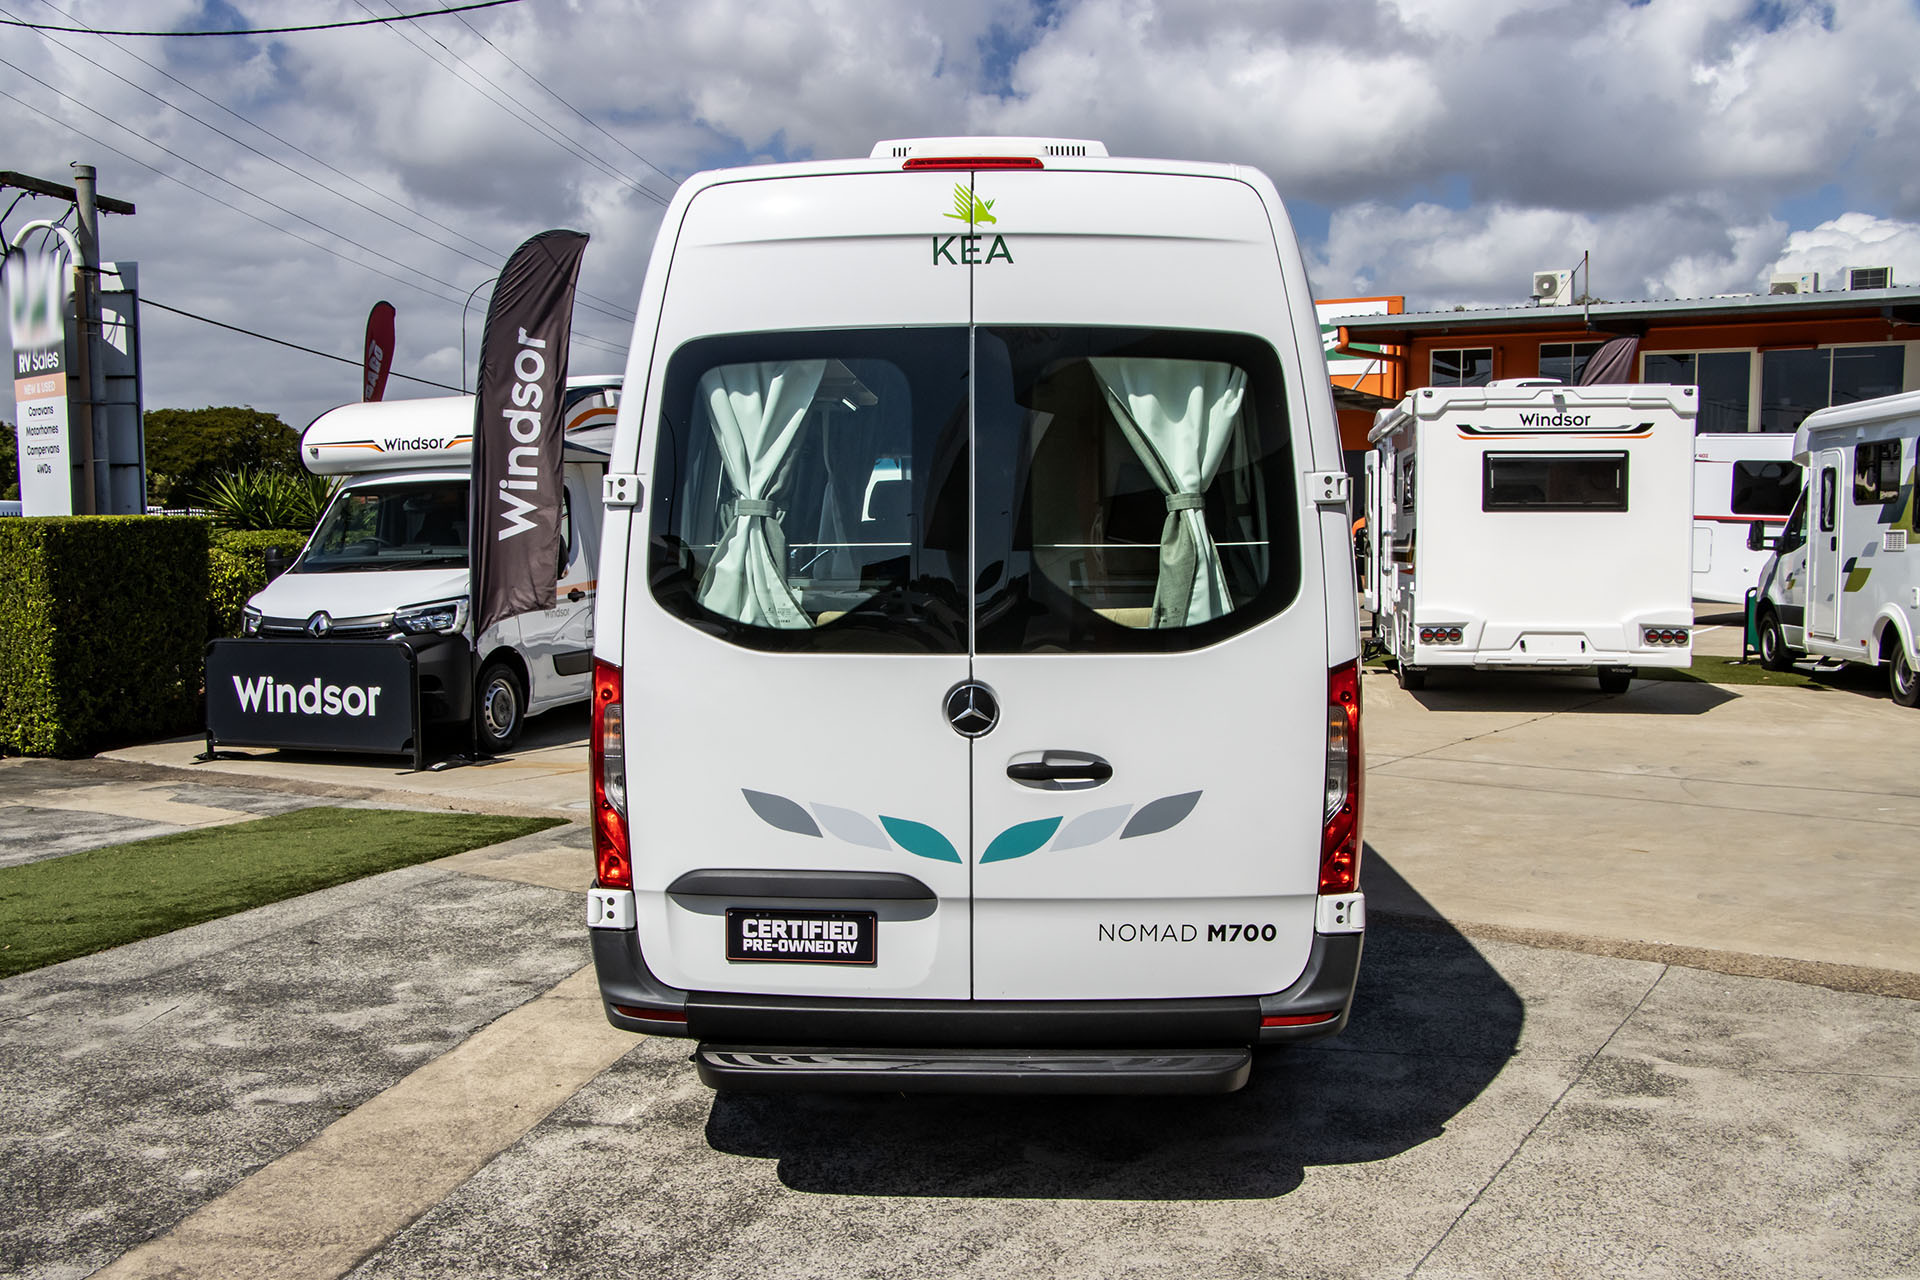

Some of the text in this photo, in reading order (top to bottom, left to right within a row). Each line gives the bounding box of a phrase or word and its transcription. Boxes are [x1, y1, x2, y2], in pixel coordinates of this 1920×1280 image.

[932, 234, 1014, 266] KEA
[19, 349, 59, 373] RV Sales
[28, 406, 54, 417] Caravans
[1519, 412, 1591, 427] Windsor
[25, 425, 59, 437] Motorhomes
[498, 326, 546, 541] Windsor
[27, 445, 60, 457] Campervans
[384, 436, 445, 451] Windsor
[232, 675, 382, 717] Windsor
[742, 918, 859, 941] CERTIFIED
[1098, 923, 1277, 943] NOMAD M700
[743, 938, 858, 954] PRE-OWNED RV
